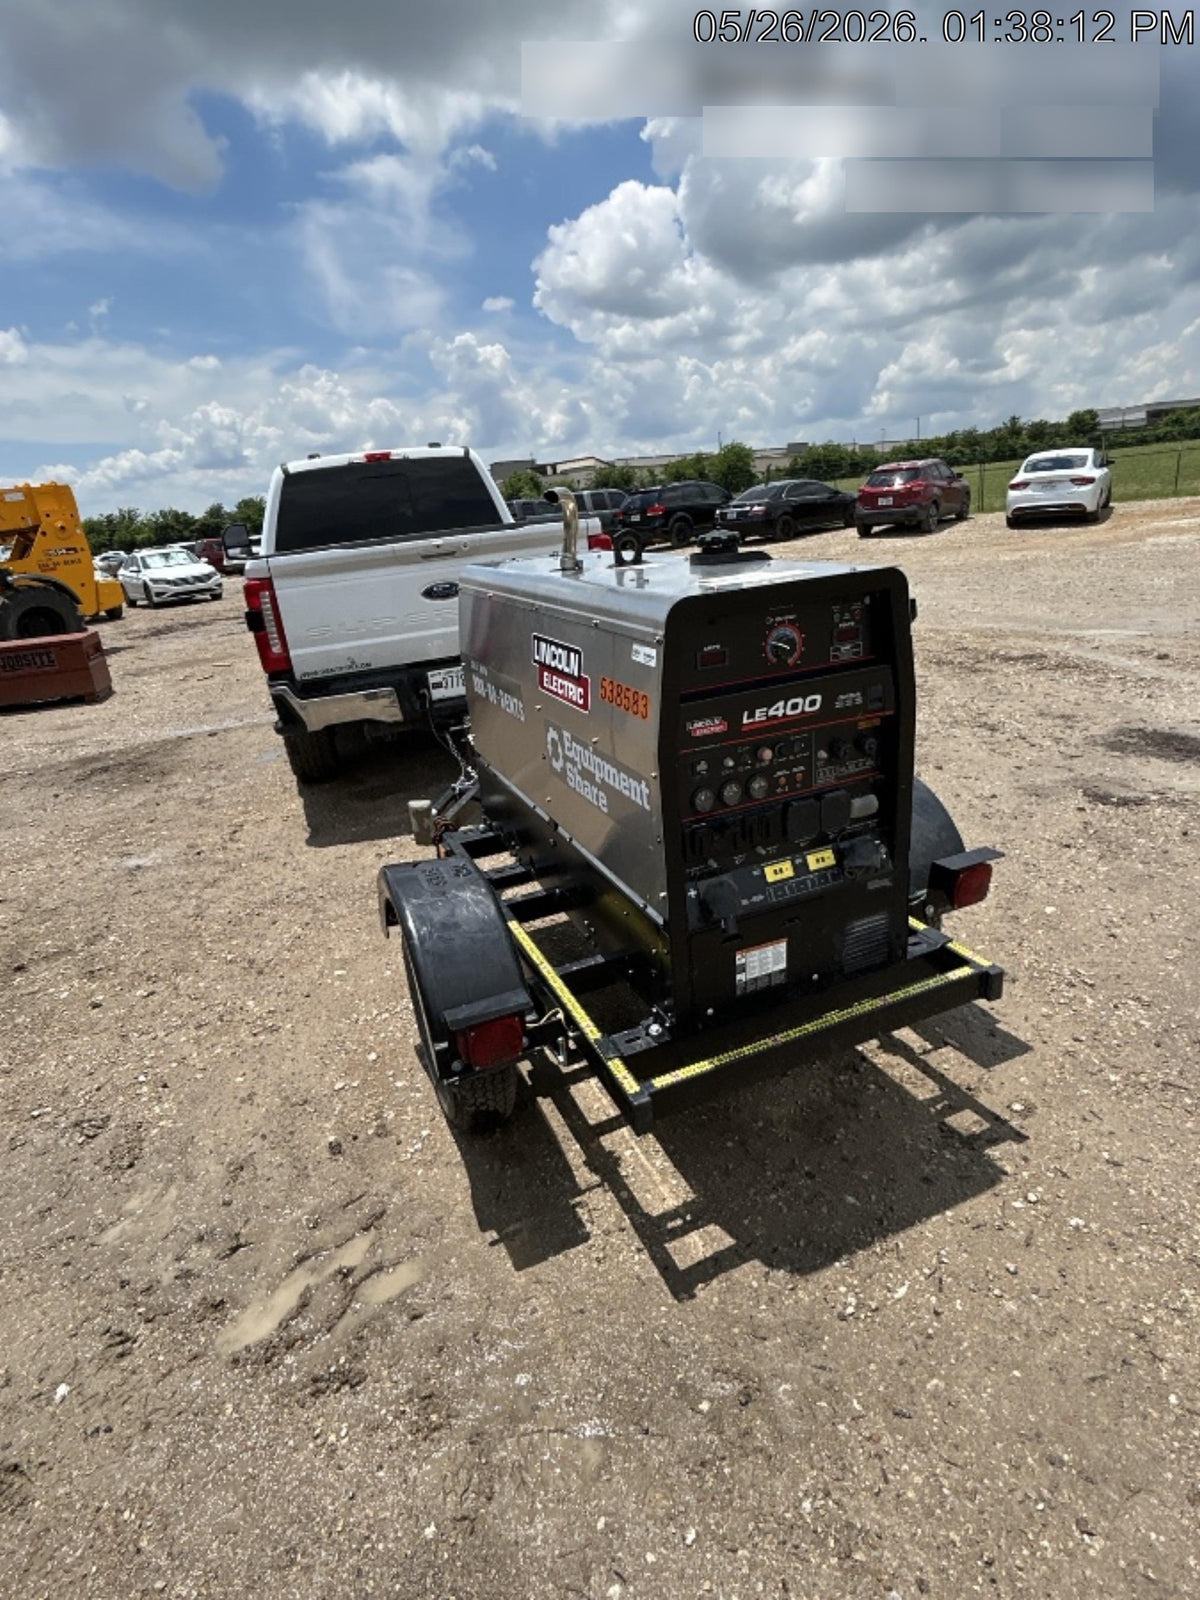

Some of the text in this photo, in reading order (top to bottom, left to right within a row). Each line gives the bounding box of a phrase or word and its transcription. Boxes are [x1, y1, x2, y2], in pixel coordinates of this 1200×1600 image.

[533, 639, 580, 678] LINCOLN
[543, 672, 584, 705] ELECTRIC
[600, 677, 649, 720] 538583
[742, 694, 823, 725] LE400
[562, 730, 651, 811] Equipment
[566, 762, 609, 814] Share
